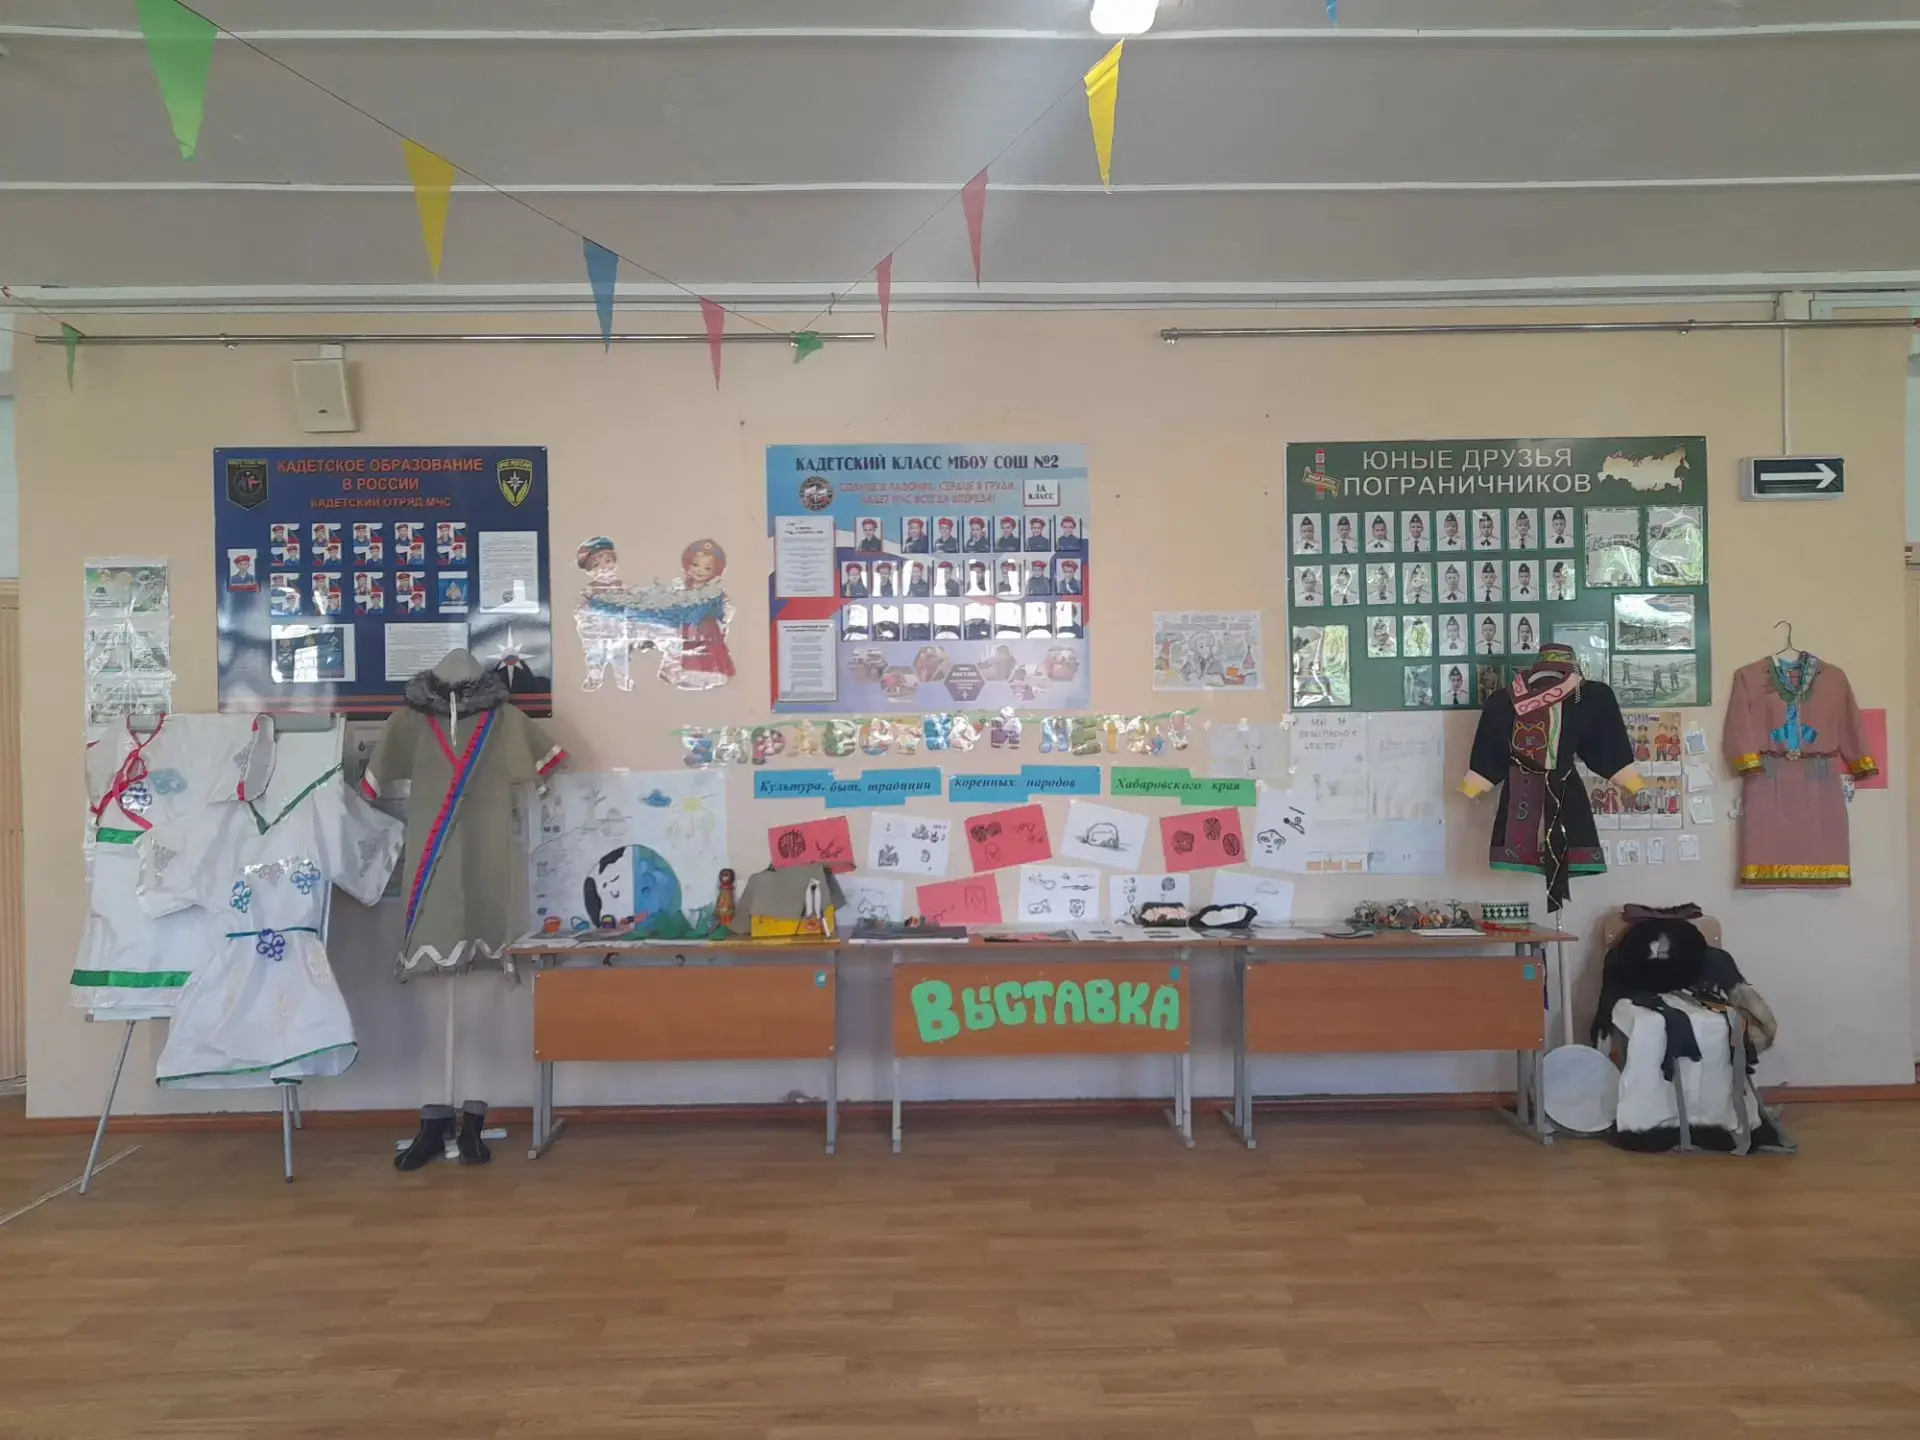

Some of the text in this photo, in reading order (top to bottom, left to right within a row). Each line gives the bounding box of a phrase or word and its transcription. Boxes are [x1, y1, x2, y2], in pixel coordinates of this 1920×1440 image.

[276, 459, 365, 473] КАДЕТСКОЕ
[370, 458, 483, 472] ОБРАЗОВАНИЕ
[796, 454, 1059, 472] КАДЕТСКИЙ КЛАСС МБОУ СОШ №2
[1363, 448, 1572, 472] ЮНЫЕ ДРУЗЬЯ
[342, 477, 419, 490] В РОССИИ
[1343, 473, 1592, 496] ПОГРАНИЧНИКОВ
[383, 497, 423, 509] ОТРЯД
[426, 496, 451, 508] МЧС
[1028, 493, 1053, 501] КЛАСС
[760, 780, 825, 795] Культура,
[867, 779, 932, 795] традиции
[955, 776, 1076, 789] коренных народов
[1116, 777, 1240, 792] Хабаровского края
